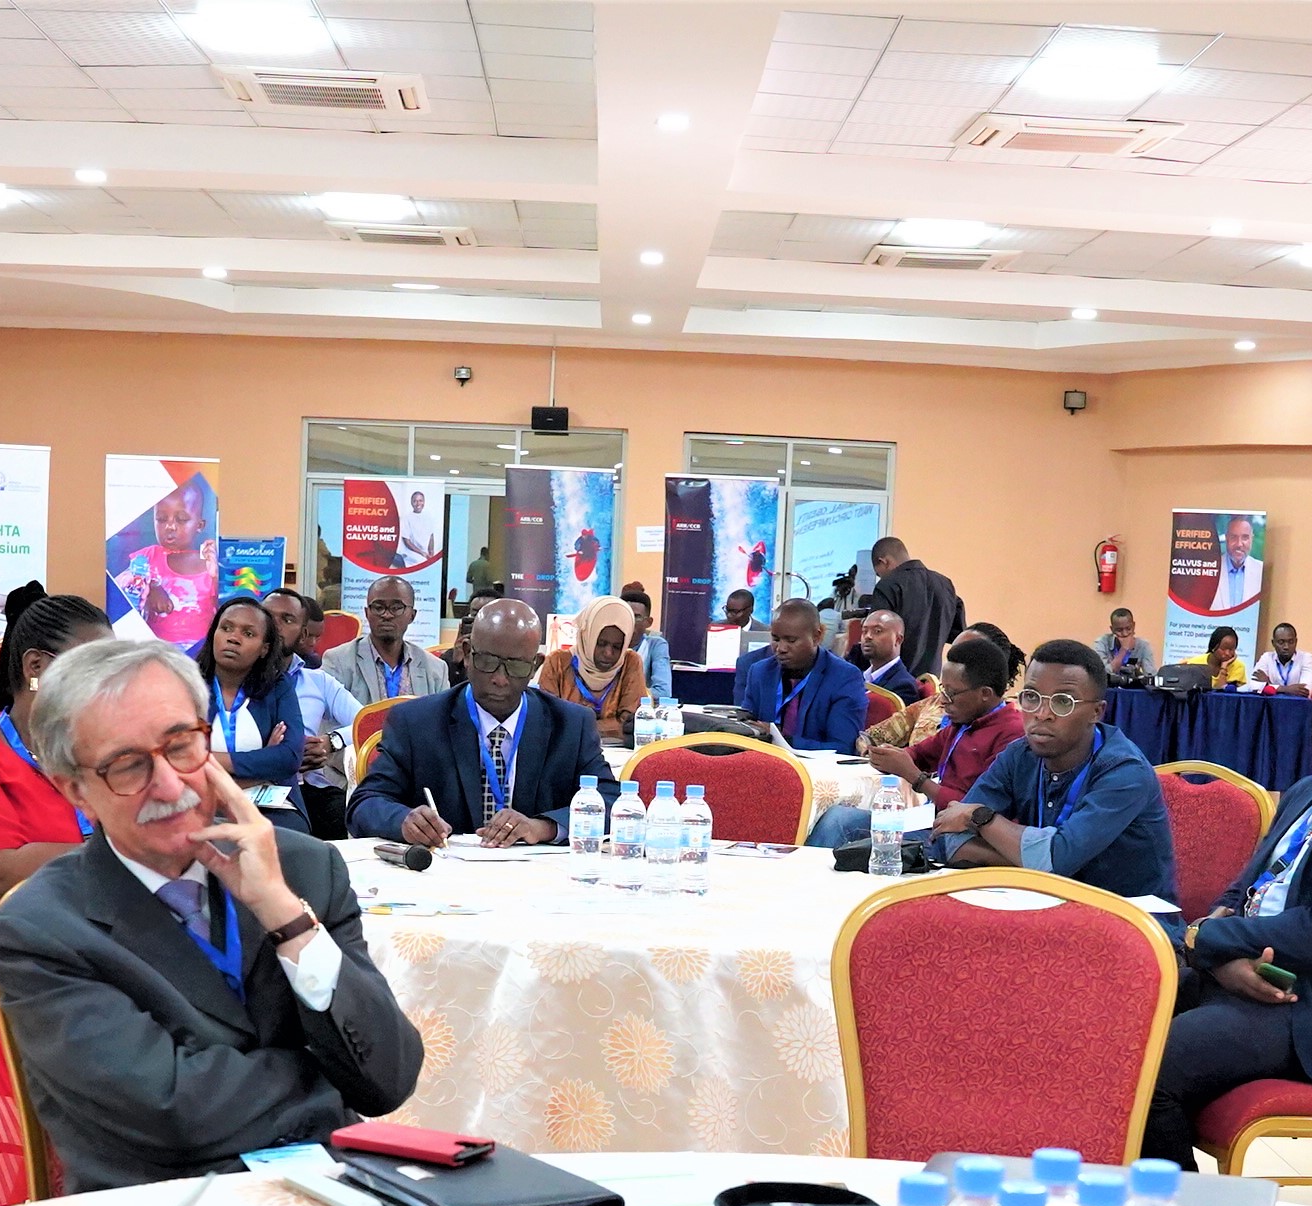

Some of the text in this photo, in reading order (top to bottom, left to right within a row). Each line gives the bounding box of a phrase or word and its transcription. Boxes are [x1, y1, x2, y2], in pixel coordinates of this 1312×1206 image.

[348, 496, 386, 506] VERIFIED
[348, 507, 389, 517] EFFICACY
[346, 524, 378, 533] GALVUS
[345, 533, 397, 542] GALVUS MET
[1176, 529, 1211, 538] VERIFIED
[1175, 541, 1213, 550] EFFICACY
[1172, 558, 1217, 568] GALVUS and
[1171, 567, 1218, 577] GALVUS MET
